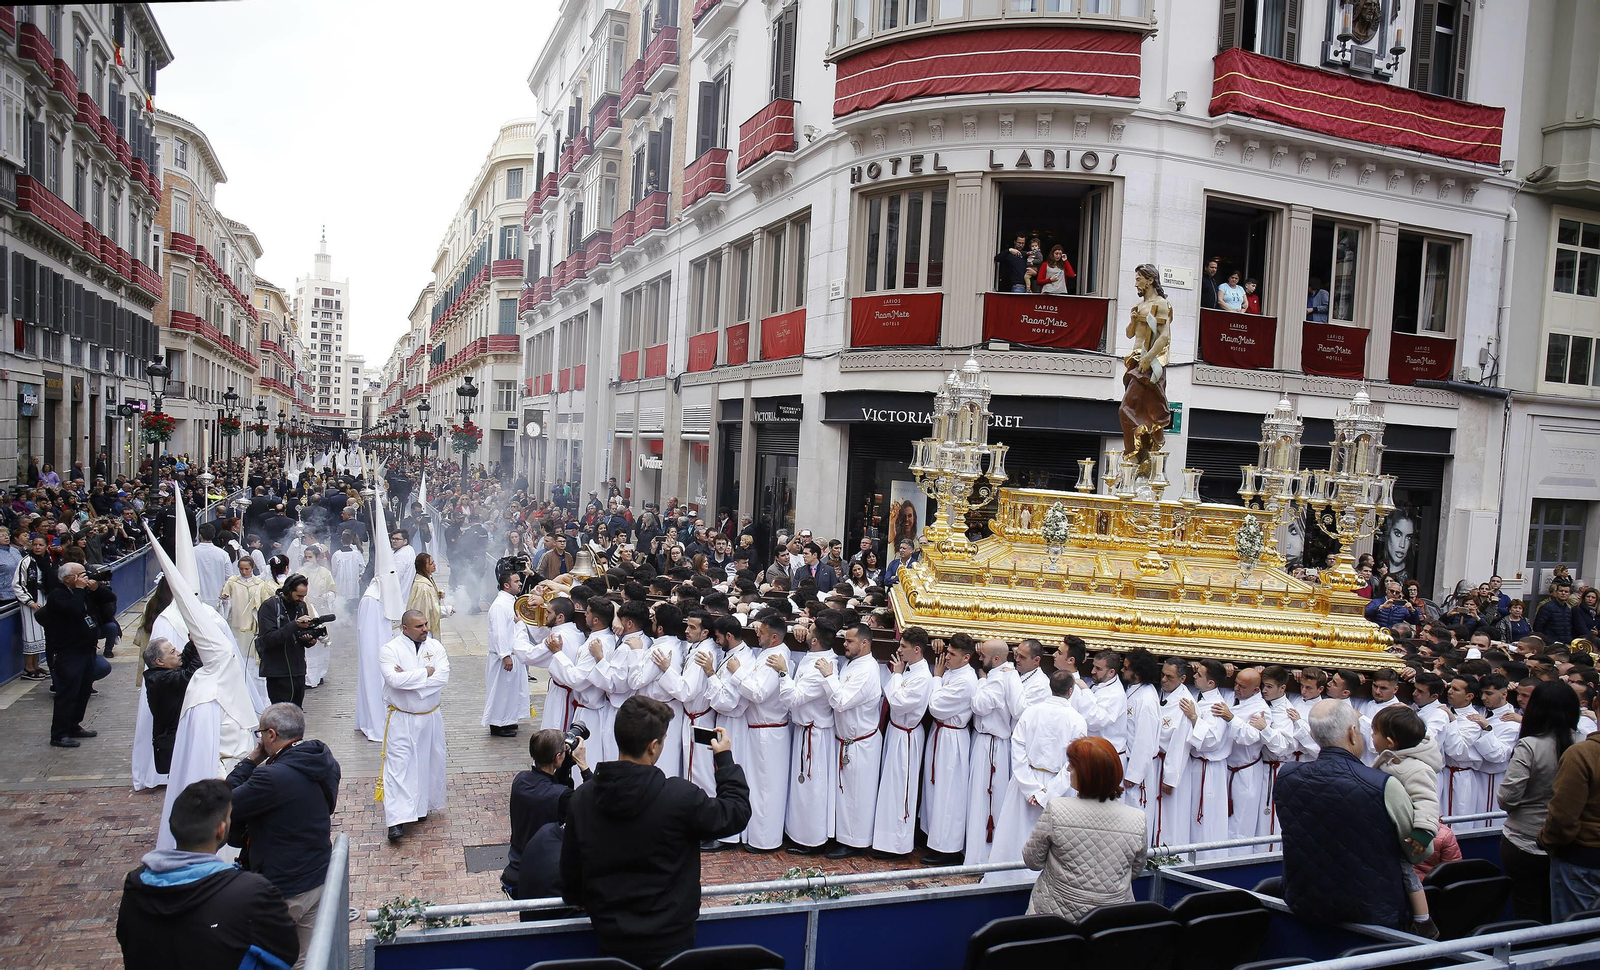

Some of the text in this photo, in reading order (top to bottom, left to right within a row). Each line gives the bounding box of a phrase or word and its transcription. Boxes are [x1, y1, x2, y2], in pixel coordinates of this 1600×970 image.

[850, 149, 1120, 184] HOTEL LARIOS
[1034, 304, 1058, 312] LARIOS
[1031, 327, 1055, 335] HOTELS
